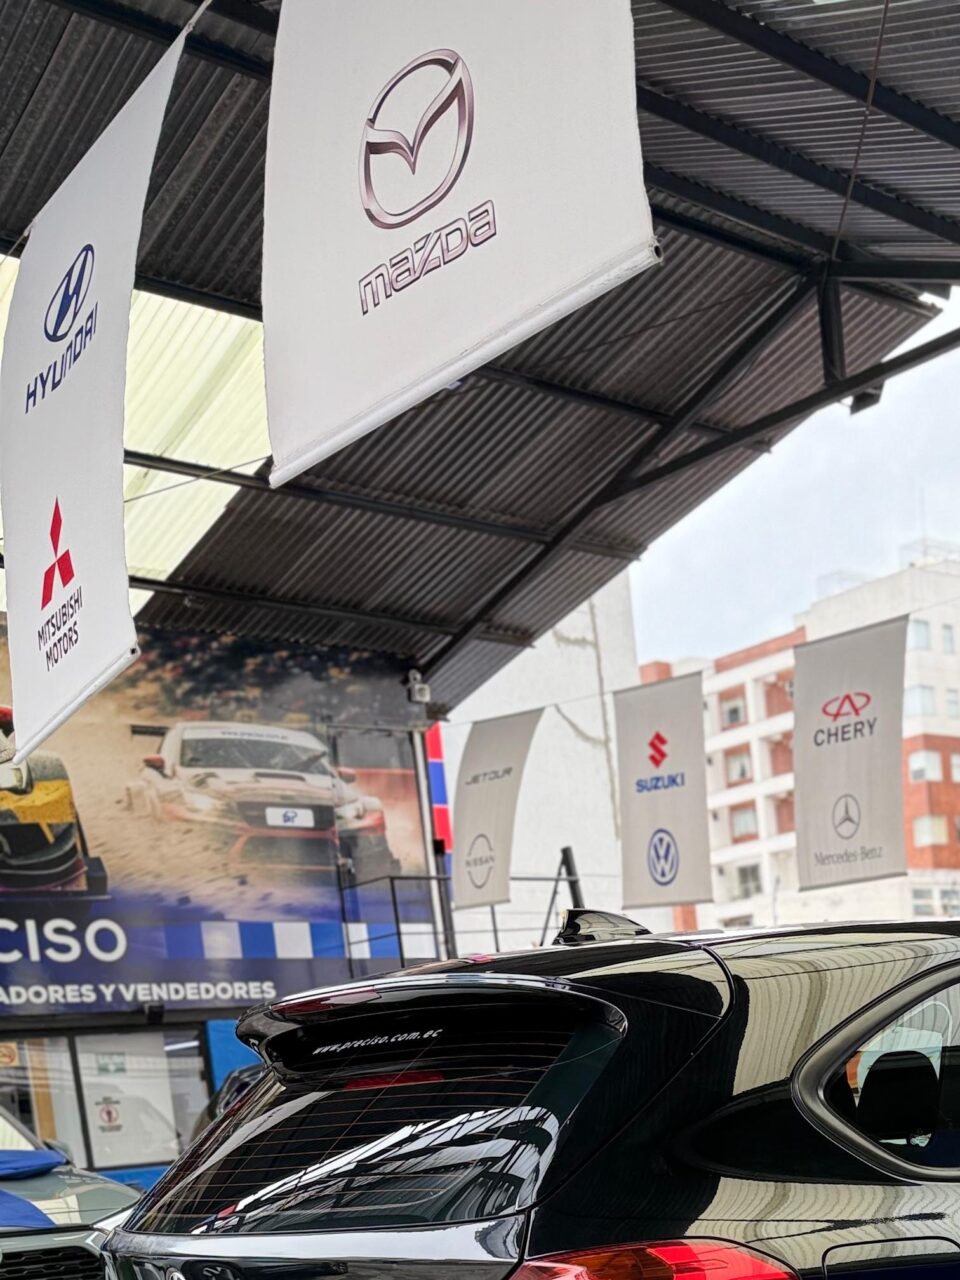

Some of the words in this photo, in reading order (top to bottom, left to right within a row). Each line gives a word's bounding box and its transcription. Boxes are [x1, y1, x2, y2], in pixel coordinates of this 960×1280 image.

[25, 301, 98, 415] HYUNDAI
[37, 585, 83, 651] MITSUBISHI
[45, 620, 79, 672] MOTORS
[813, 717, 877, 747] CHERY
[465, 766, 513, 786] JETOUR
[635, 772, 685, 793] SUZUKI
[814, 846, 883, 867] Mercedes-Benz
[100, 983, 116, 1001] Y
[118, 981, 276, 1001] VENDEDORES
[312, 1028, 444, 1055] www.preciso.com.ec
